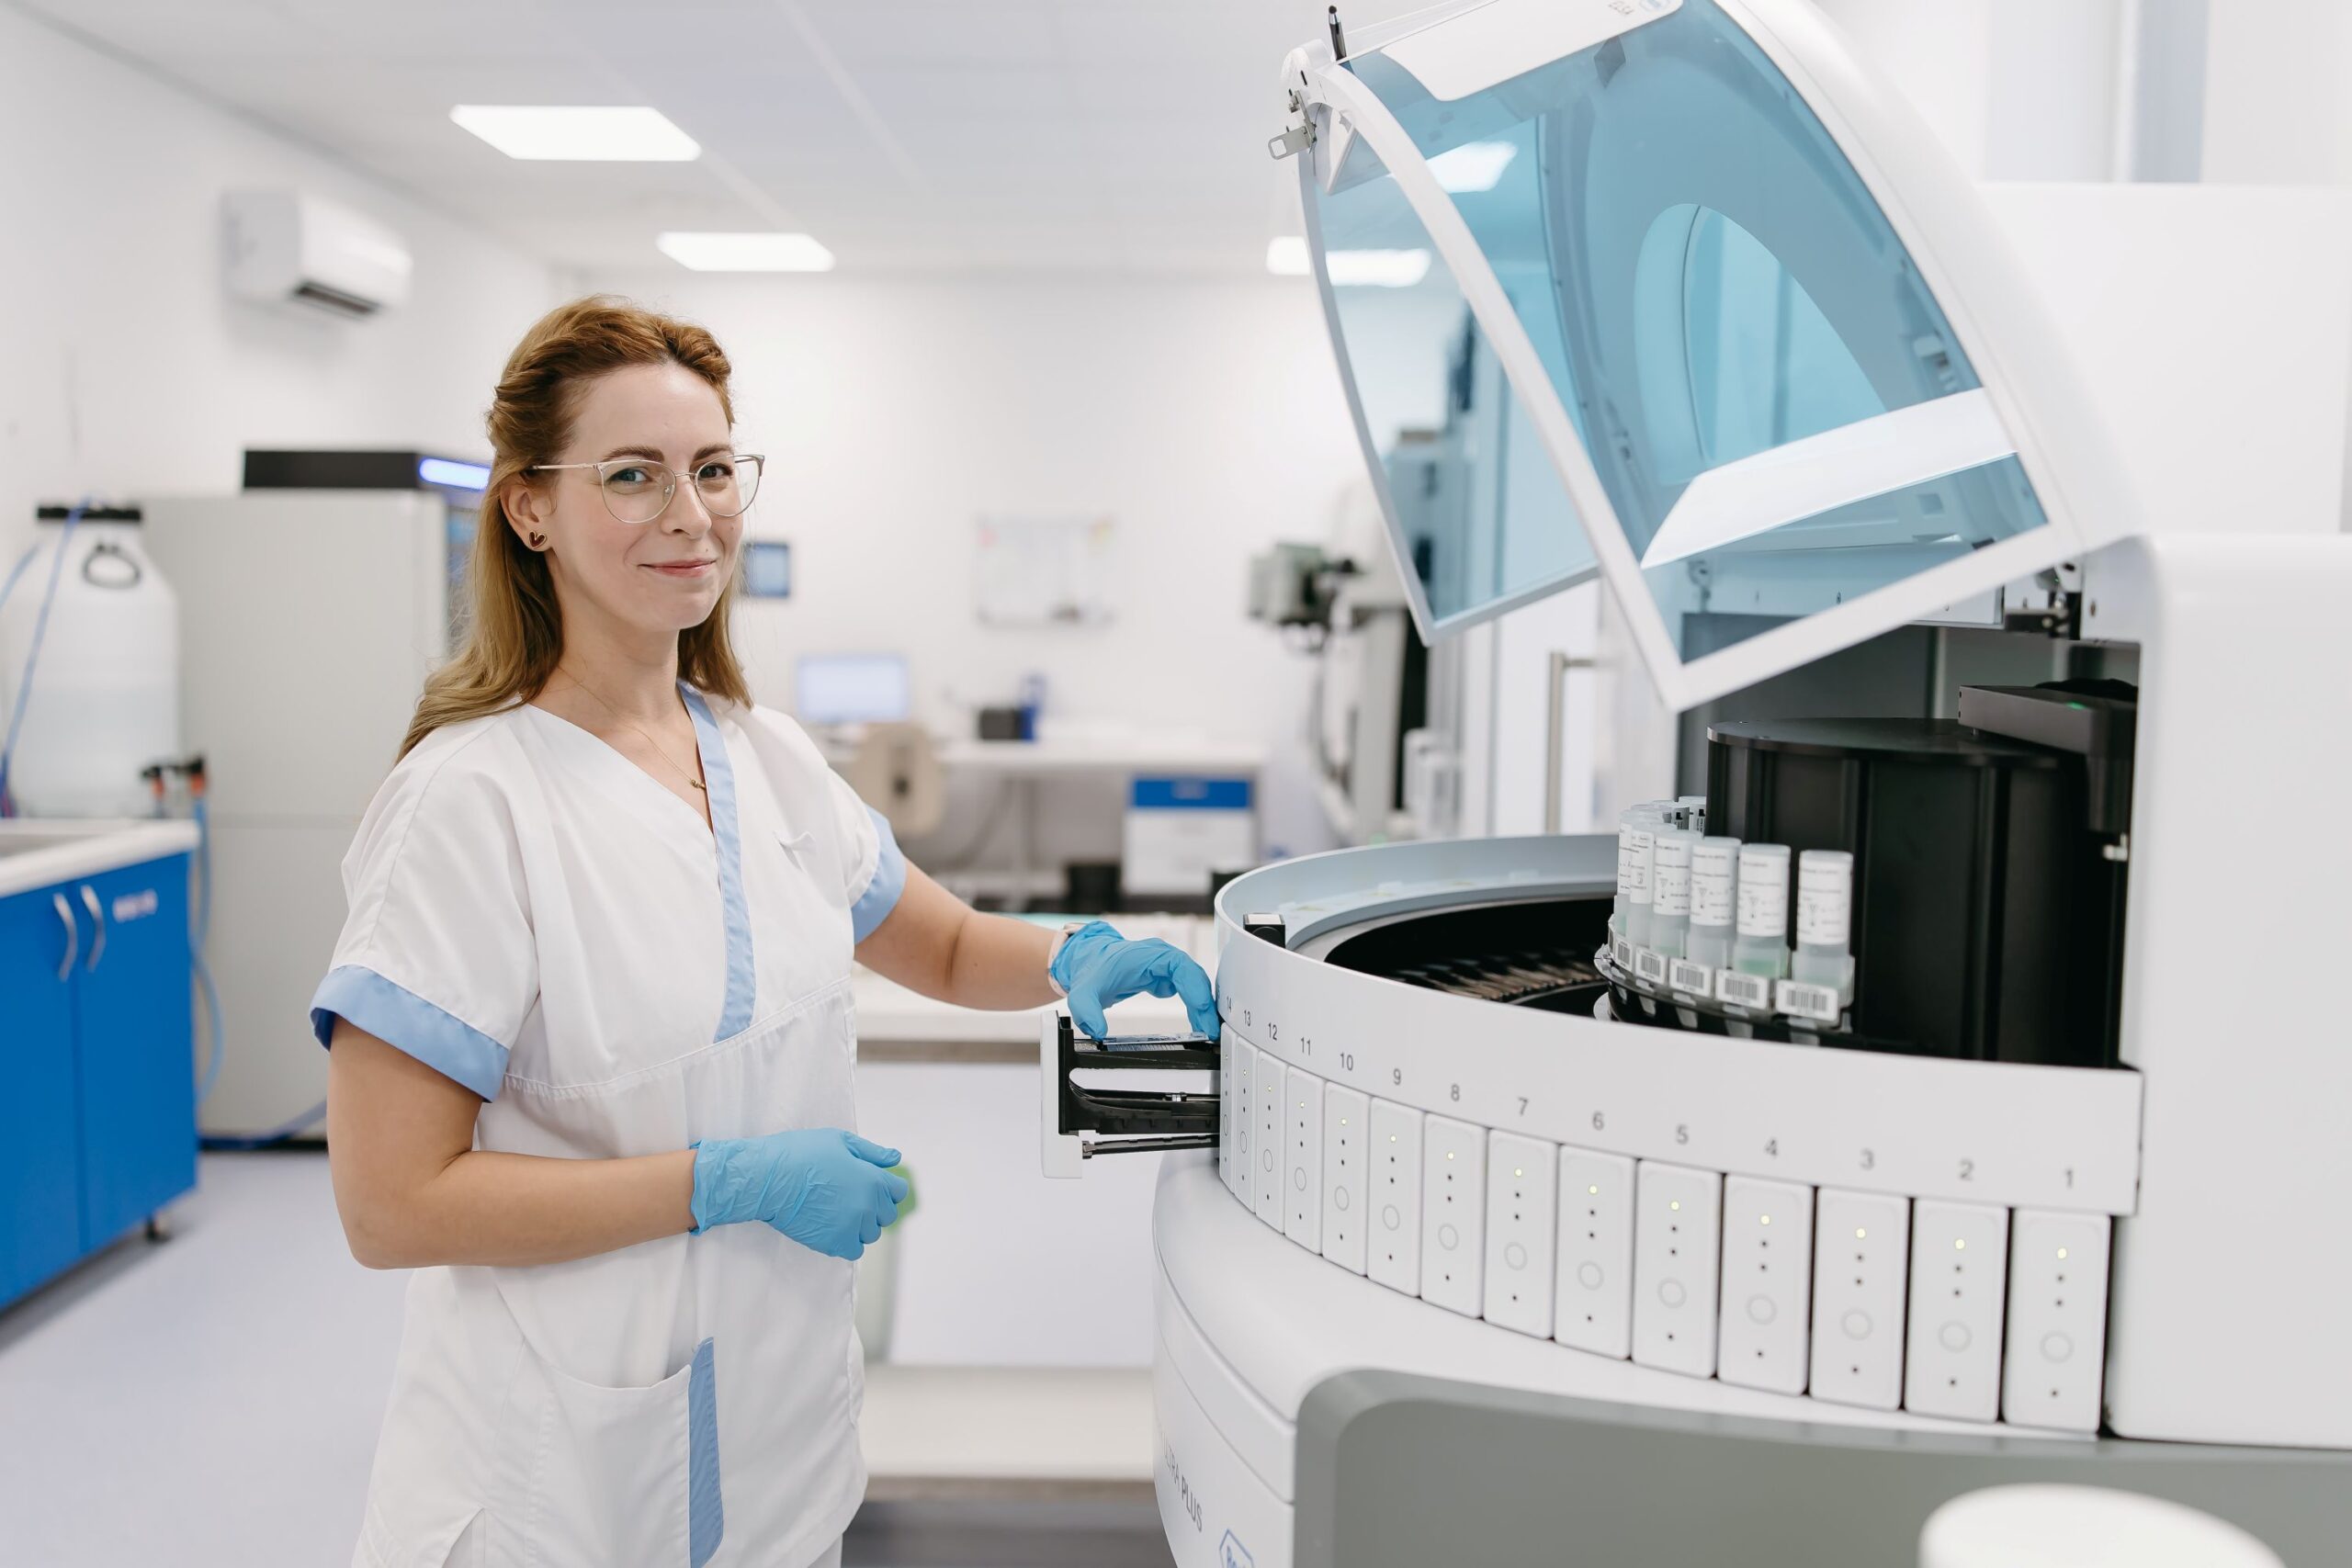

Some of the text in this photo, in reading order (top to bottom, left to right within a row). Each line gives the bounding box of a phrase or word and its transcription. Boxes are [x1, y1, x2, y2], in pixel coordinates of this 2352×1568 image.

[1227, 996, 1233, 1013] 14
[1243, 1009, 1252, 1028] 13
[1267, 1021, 1278, 1042] 12
[1300, 1036, 1311, 1056] 11
[1340, 1052, 1353, 1072] 10
[1393, 1067, 1402, 1086] 9
[1451, 1083, 1461, 1102] 8
[1518, 1097, 1529, 1116] 7
[1592, 1111, 1604, 1131] 6
[1677, 1124, 1689, 1145] 5
[1765, 1138, 1779, 1158] 4
[1860, 1149, 1875, 1170] 3
[1959, 1160, 1974, 1181] 2
[2064, 1168, 2075, 1189] 1
[1182, 1474, 1203, 1533] PLUS
